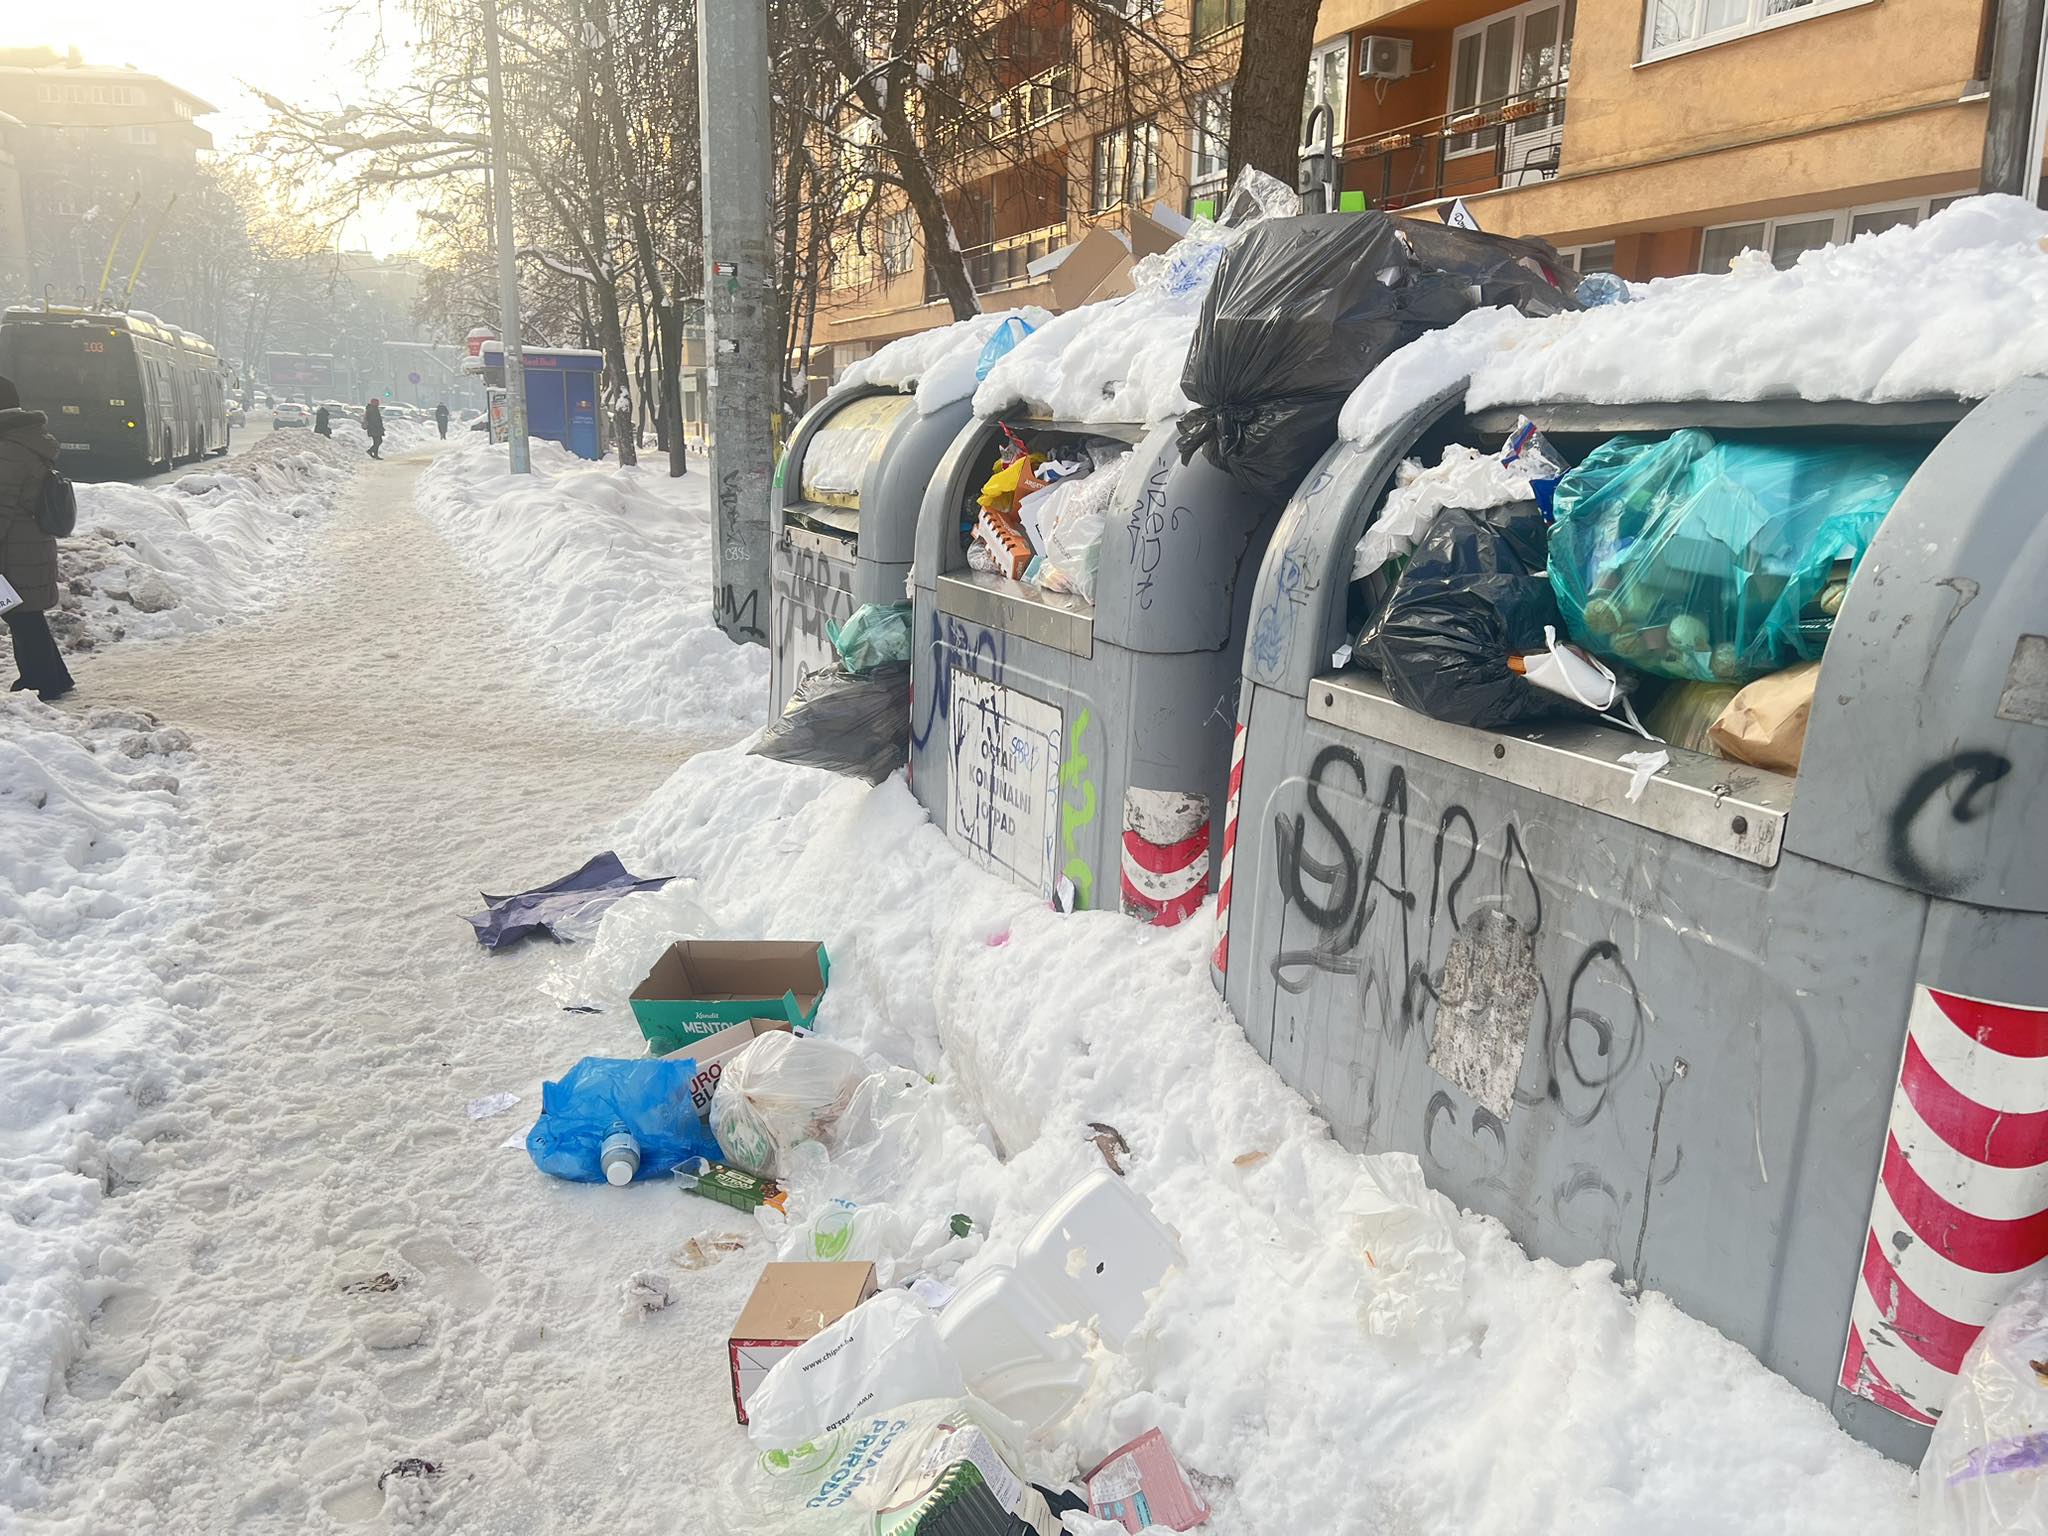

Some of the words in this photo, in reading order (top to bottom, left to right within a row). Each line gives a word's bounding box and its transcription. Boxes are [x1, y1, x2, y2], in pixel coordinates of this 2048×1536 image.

[981, 739, 1017, 775] OSTALI
[969, 763, 1032, 815] KOMUNALNI
[682, 1020, 734, 1034] MENTO
